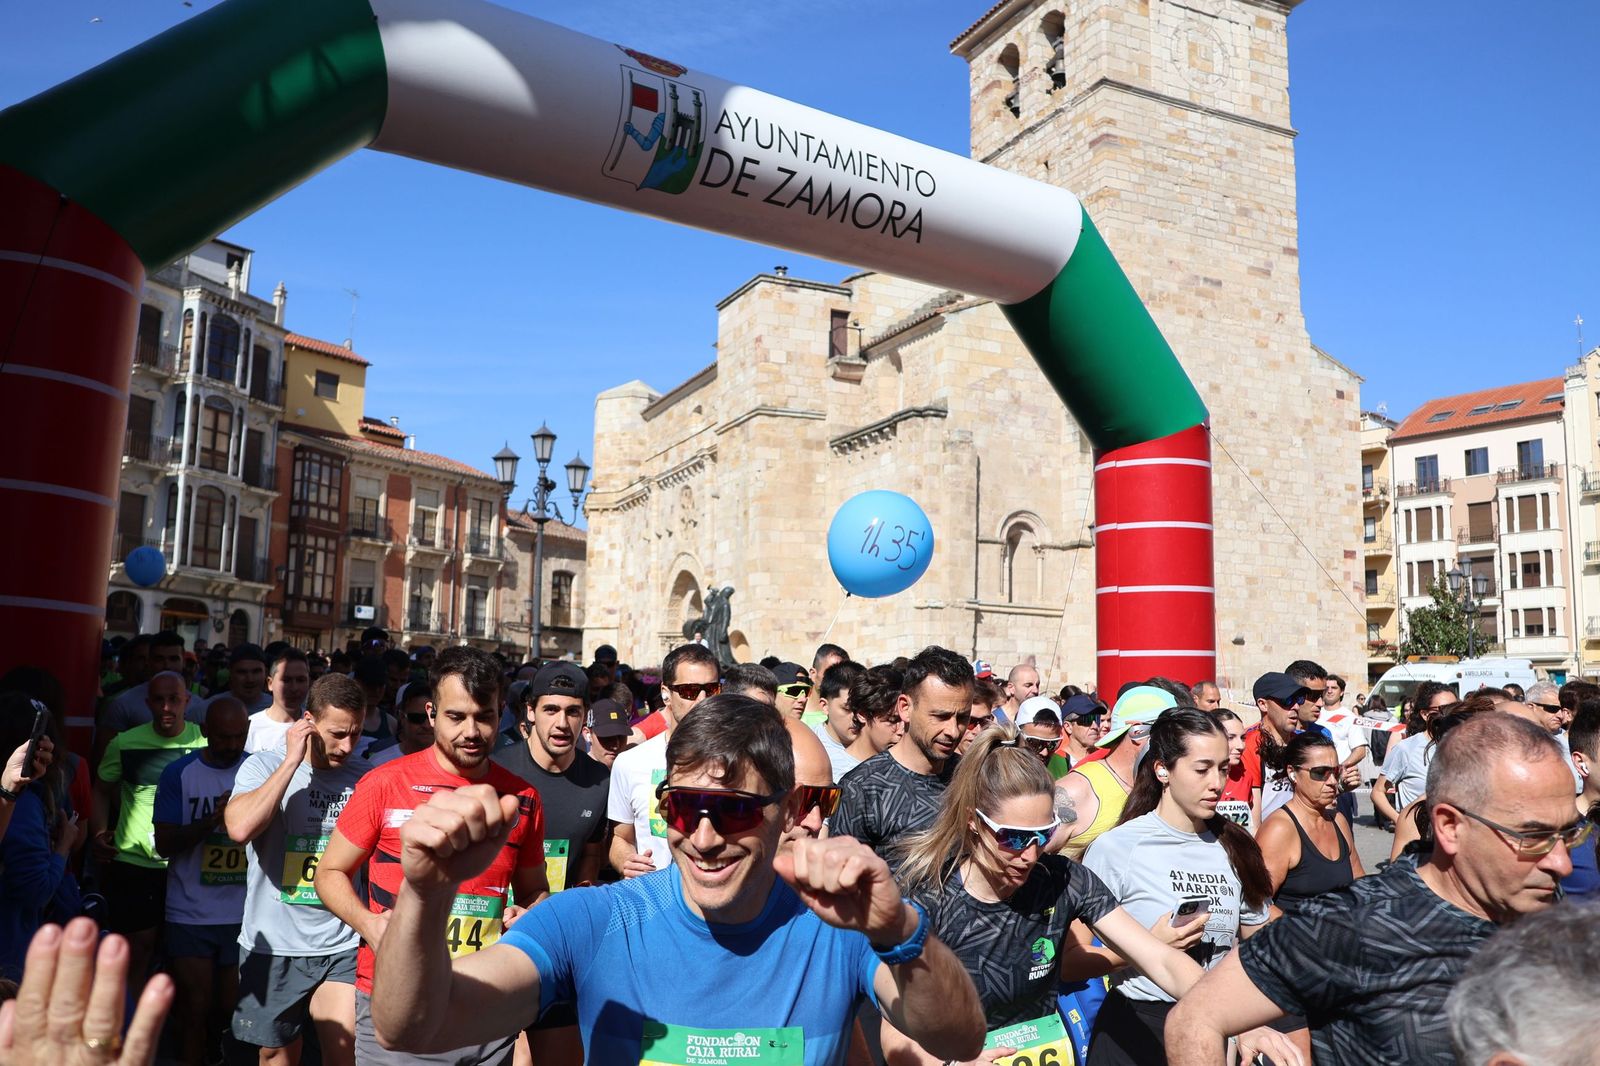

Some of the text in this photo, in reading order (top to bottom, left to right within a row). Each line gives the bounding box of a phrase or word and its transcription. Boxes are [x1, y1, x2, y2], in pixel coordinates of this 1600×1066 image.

[714, 108, 936, 198] AYUNTAMIENTO
[699, 147, 923, 243] DE ZAMORA
[309, 800, 347, 809] MARAT
[208, 848, 248, 869] 20
[1187, 872, 1228, 884] MEDIA
[686, 1045, 761, 1058] CAJA RURAL
[697, 1057, 728, 1065] ZAMORA
